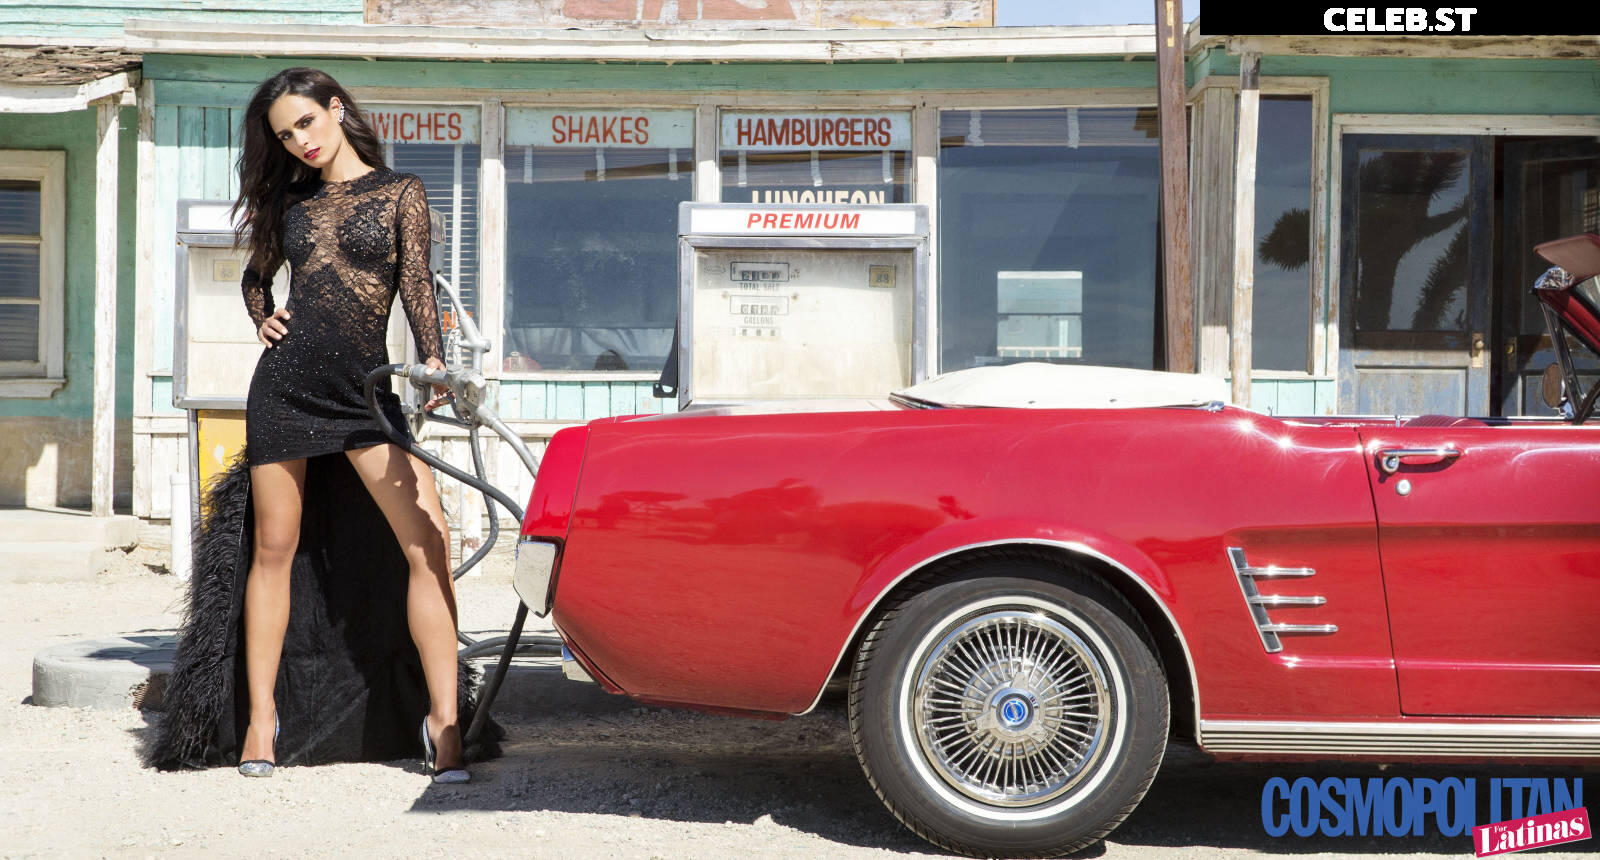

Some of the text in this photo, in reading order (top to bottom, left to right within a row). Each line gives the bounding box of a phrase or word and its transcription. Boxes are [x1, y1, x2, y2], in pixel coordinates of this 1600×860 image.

[367, 112, 462, 140] WICHES
[552, 115, 650, 145] SHAKES
[736, 117, 892, 147] HAMBURGERS
[747, 213, 861, 229] PREMIUM
